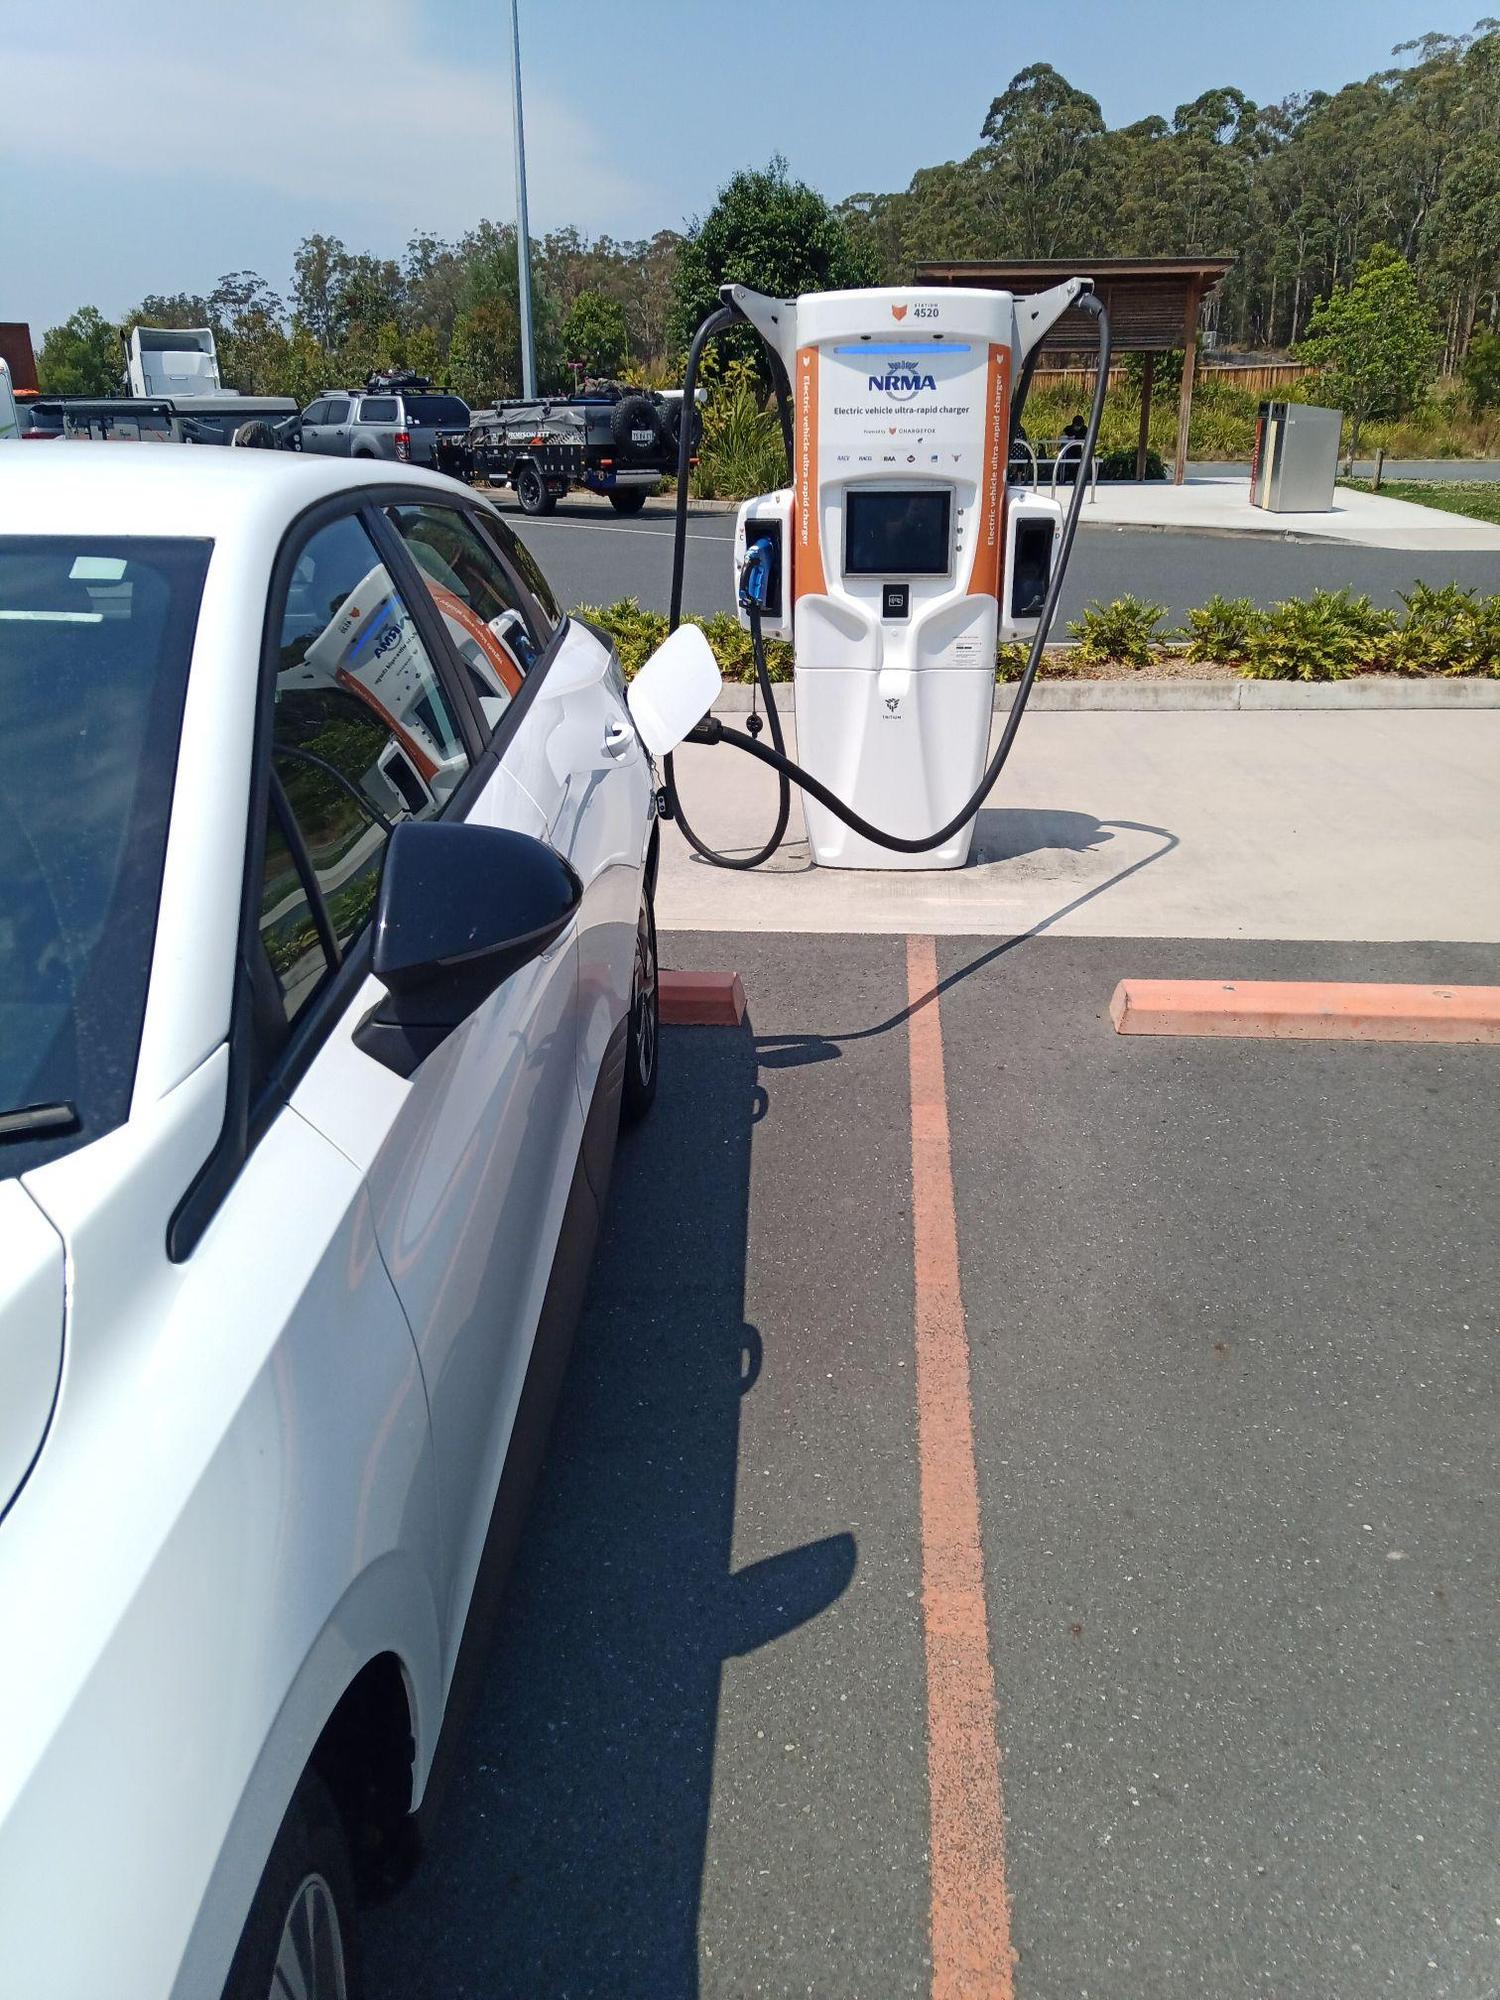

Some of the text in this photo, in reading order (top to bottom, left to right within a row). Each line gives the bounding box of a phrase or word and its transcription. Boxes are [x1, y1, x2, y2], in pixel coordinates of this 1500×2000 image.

[913, 308, 940, 318] 4520
[868, 375, 937, 391] NRMA
[834, 405, 970, 416] Electric vehicle ultra-rapid charger
[801, 375, 811, 546] Electric vehicle ultra-rapid charger
[987, 373, 1003, 546] Electric vehicle ultra-rapid charger
